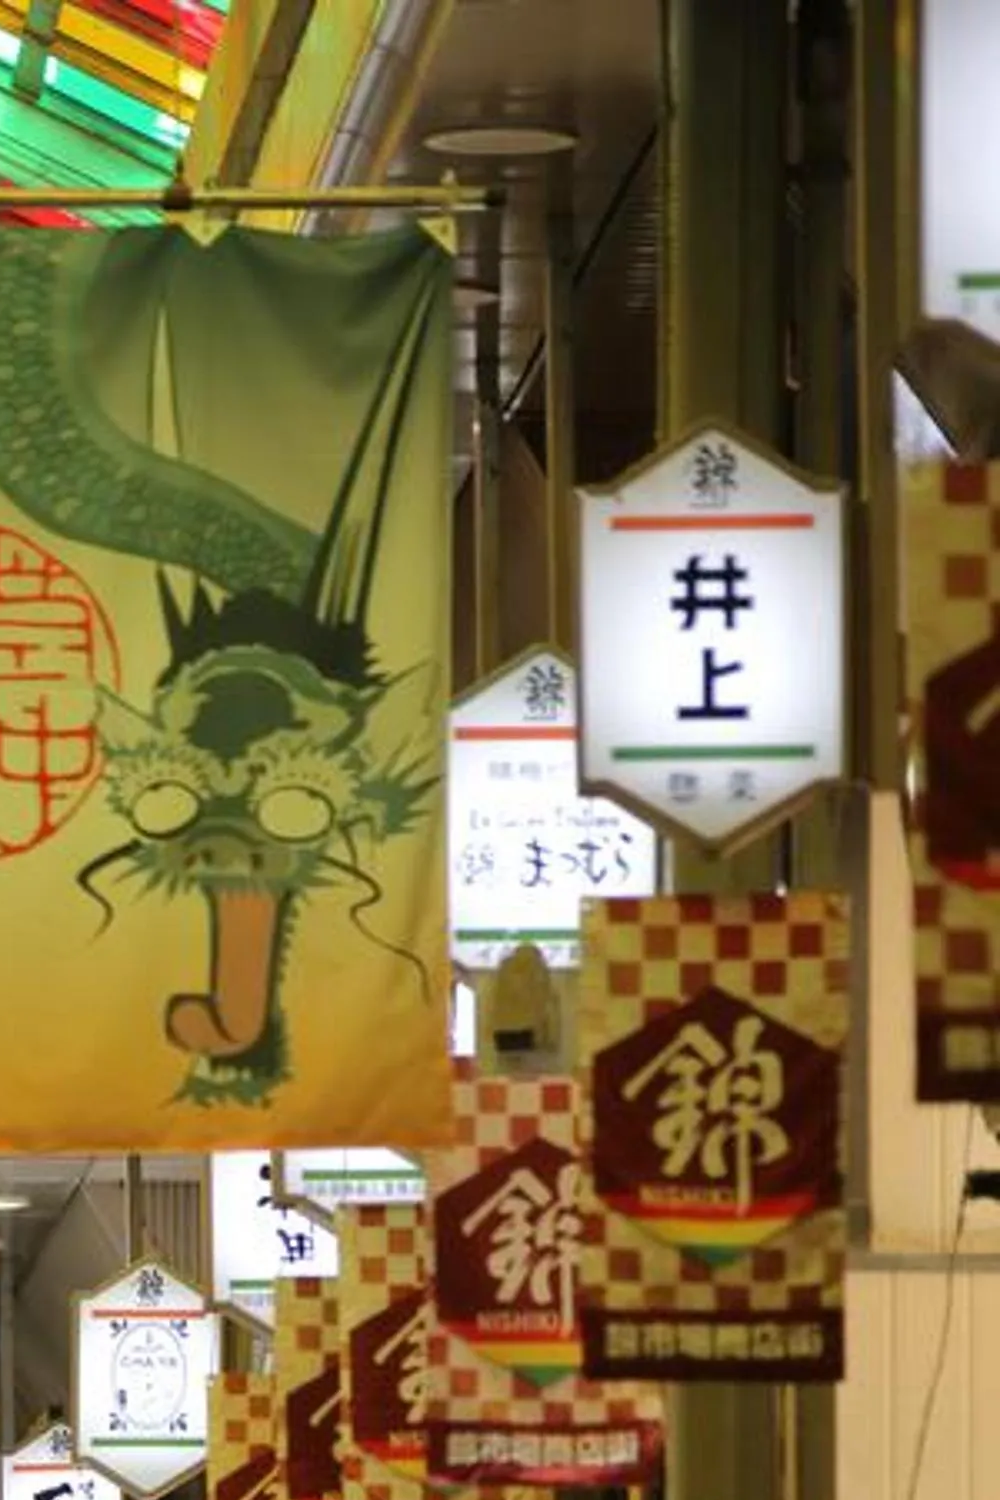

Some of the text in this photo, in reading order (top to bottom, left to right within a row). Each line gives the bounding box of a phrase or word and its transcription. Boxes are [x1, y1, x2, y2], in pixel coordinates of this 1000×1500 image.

[670, 554, 753, 719] 井上
[621, 1016, 789, 1218] 錦
[462, 1163, 583, 1337] 錦
